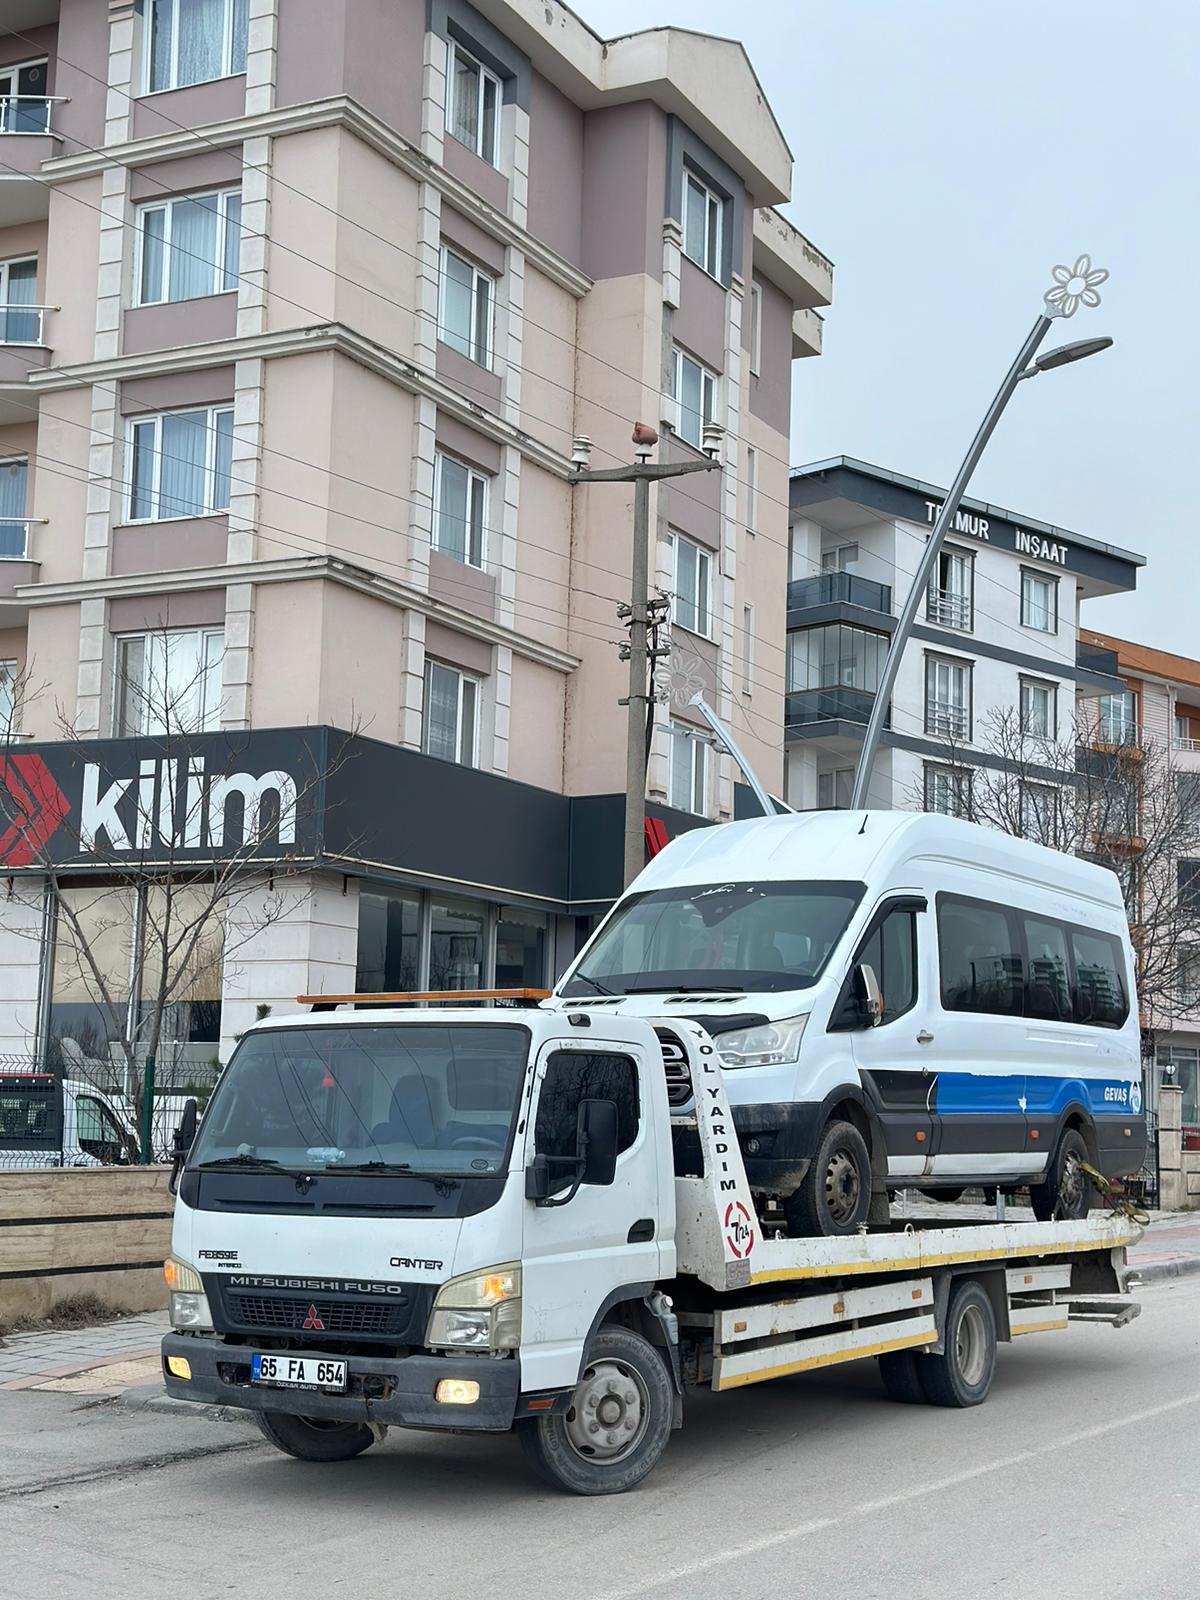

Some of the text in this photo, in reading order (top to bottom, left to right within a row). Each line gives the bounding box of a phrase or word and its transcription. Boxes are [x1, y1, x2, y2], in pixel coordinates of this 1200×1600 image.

[1015, 527, 1068, 565] İNŞAAT
[80, 757, 298, 852] kilim
[1104, 1086, 1127, 1106] GEVAŞ
[691, 1030, 737, 1192] YOL YARDIM
[389, 1257, 444, 1270] CANTER
[230, 1276, 402, 1295] MITSUBISHI FUSO
[261, 1358, 277, 1378] 65
[288, 1360, 305, 1381] FA
[317, 1363, 343, 1384] 654
